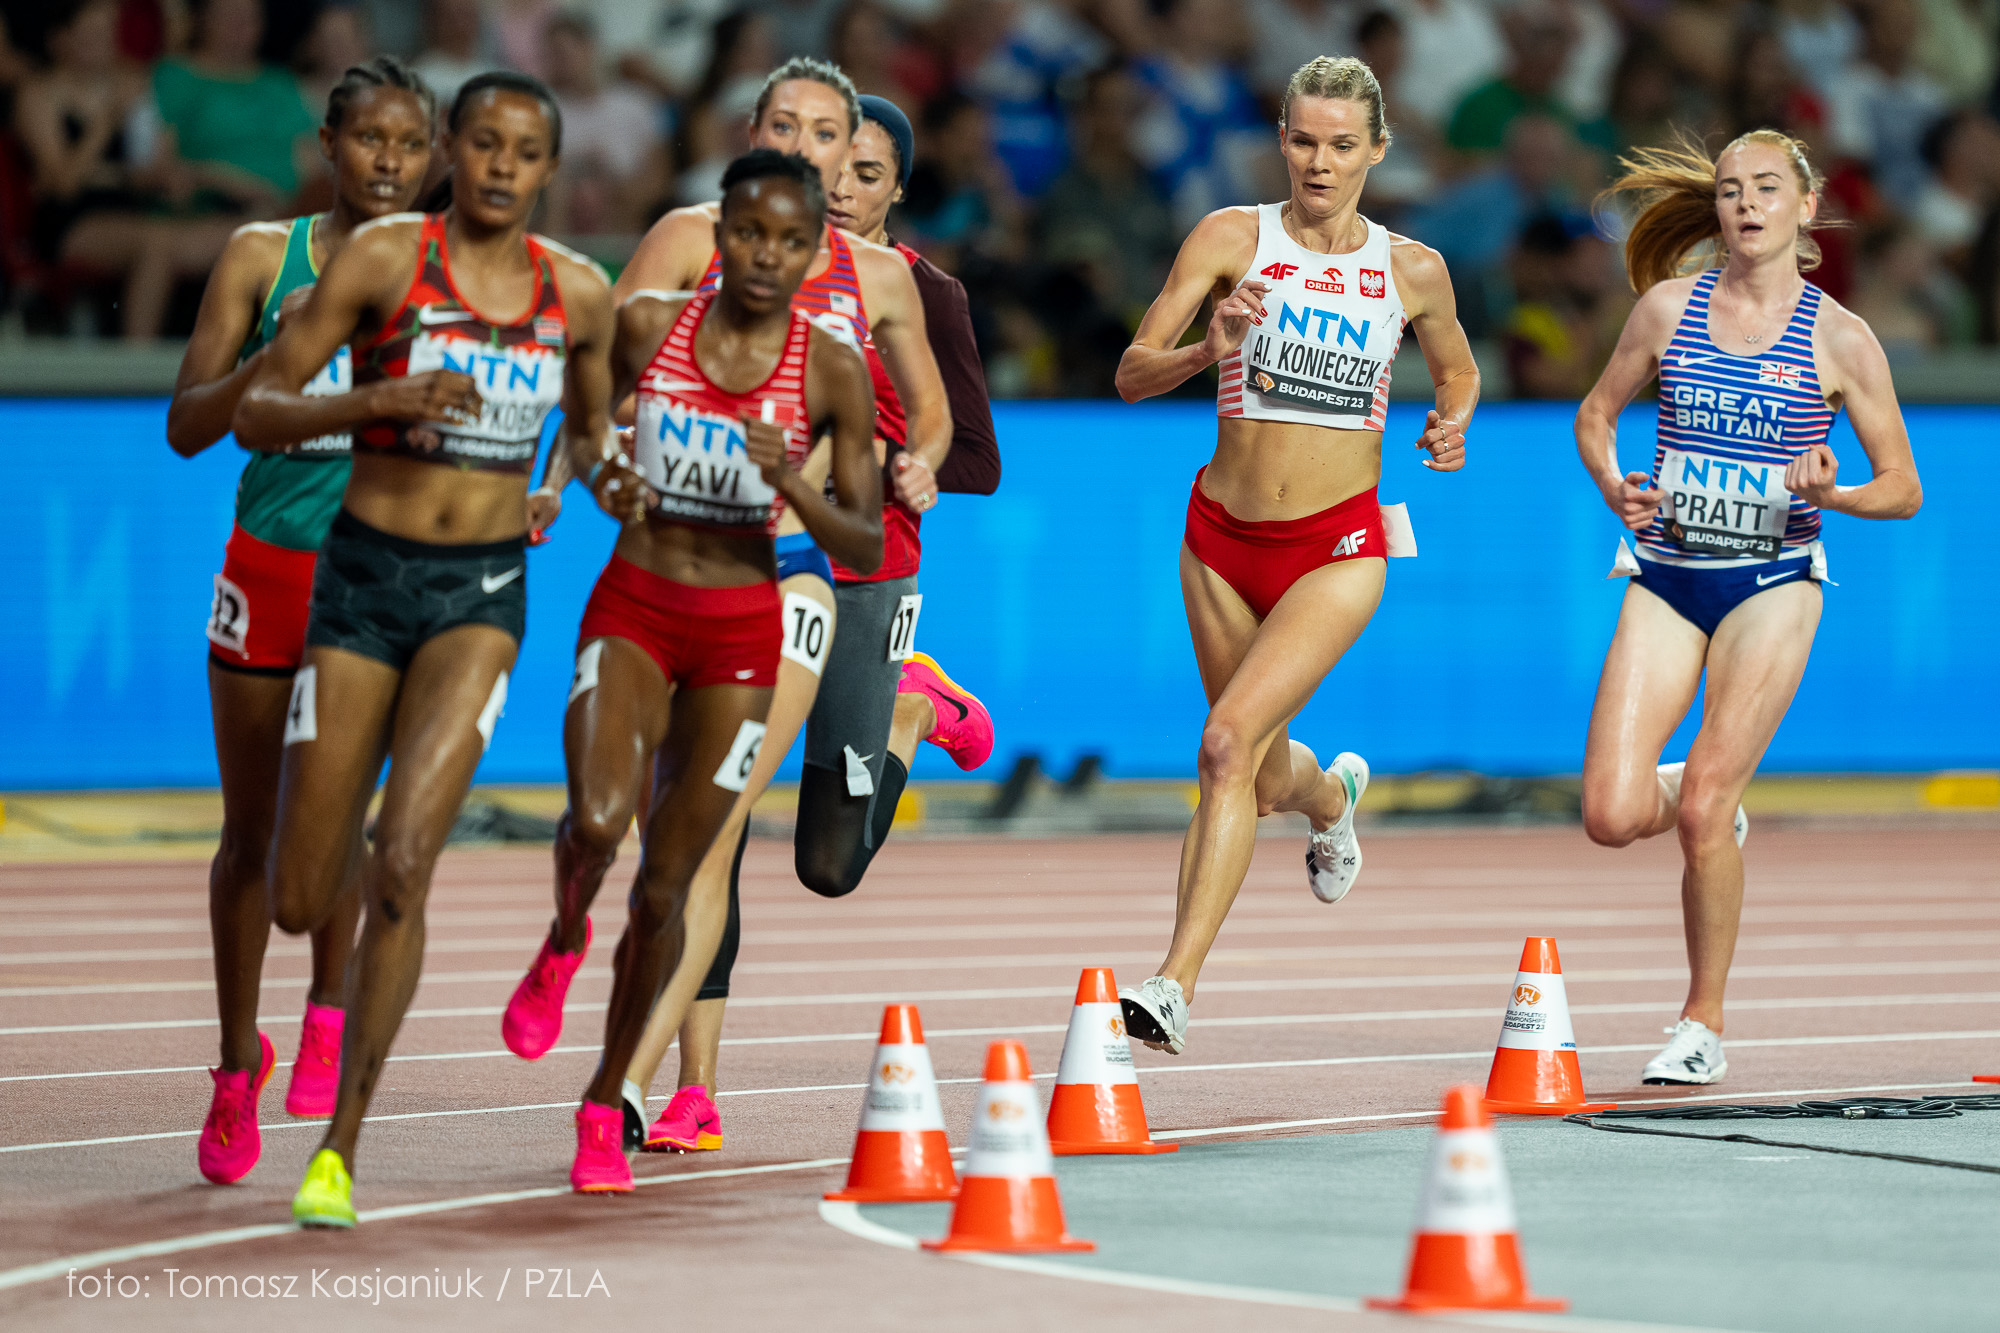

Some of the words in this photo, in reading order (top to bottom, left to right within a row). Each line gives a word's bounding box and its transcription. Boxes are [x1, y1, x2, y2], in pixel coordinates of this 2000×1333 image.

[1260, 262, 1299, 280] 4F
[1306, 281, 1343, 293] ORLEN
[1277, 301, 1371, 352] NTN
[442, 350, 540, 393] NTN
[1277, 341, 1382, 388] KONIECZEK
[1674, 385, 1786, 420] GREAT
[1674, 408, 1783, 442] BRITAIN
[662, 455, 741, 499] YAVI
[1682, 455, 1768, 498] NTN
[1673, 491, 1768, 532] PRATT
[1331, 528, 1367, 557] 4F
[793, 607, 824, 659] 10
